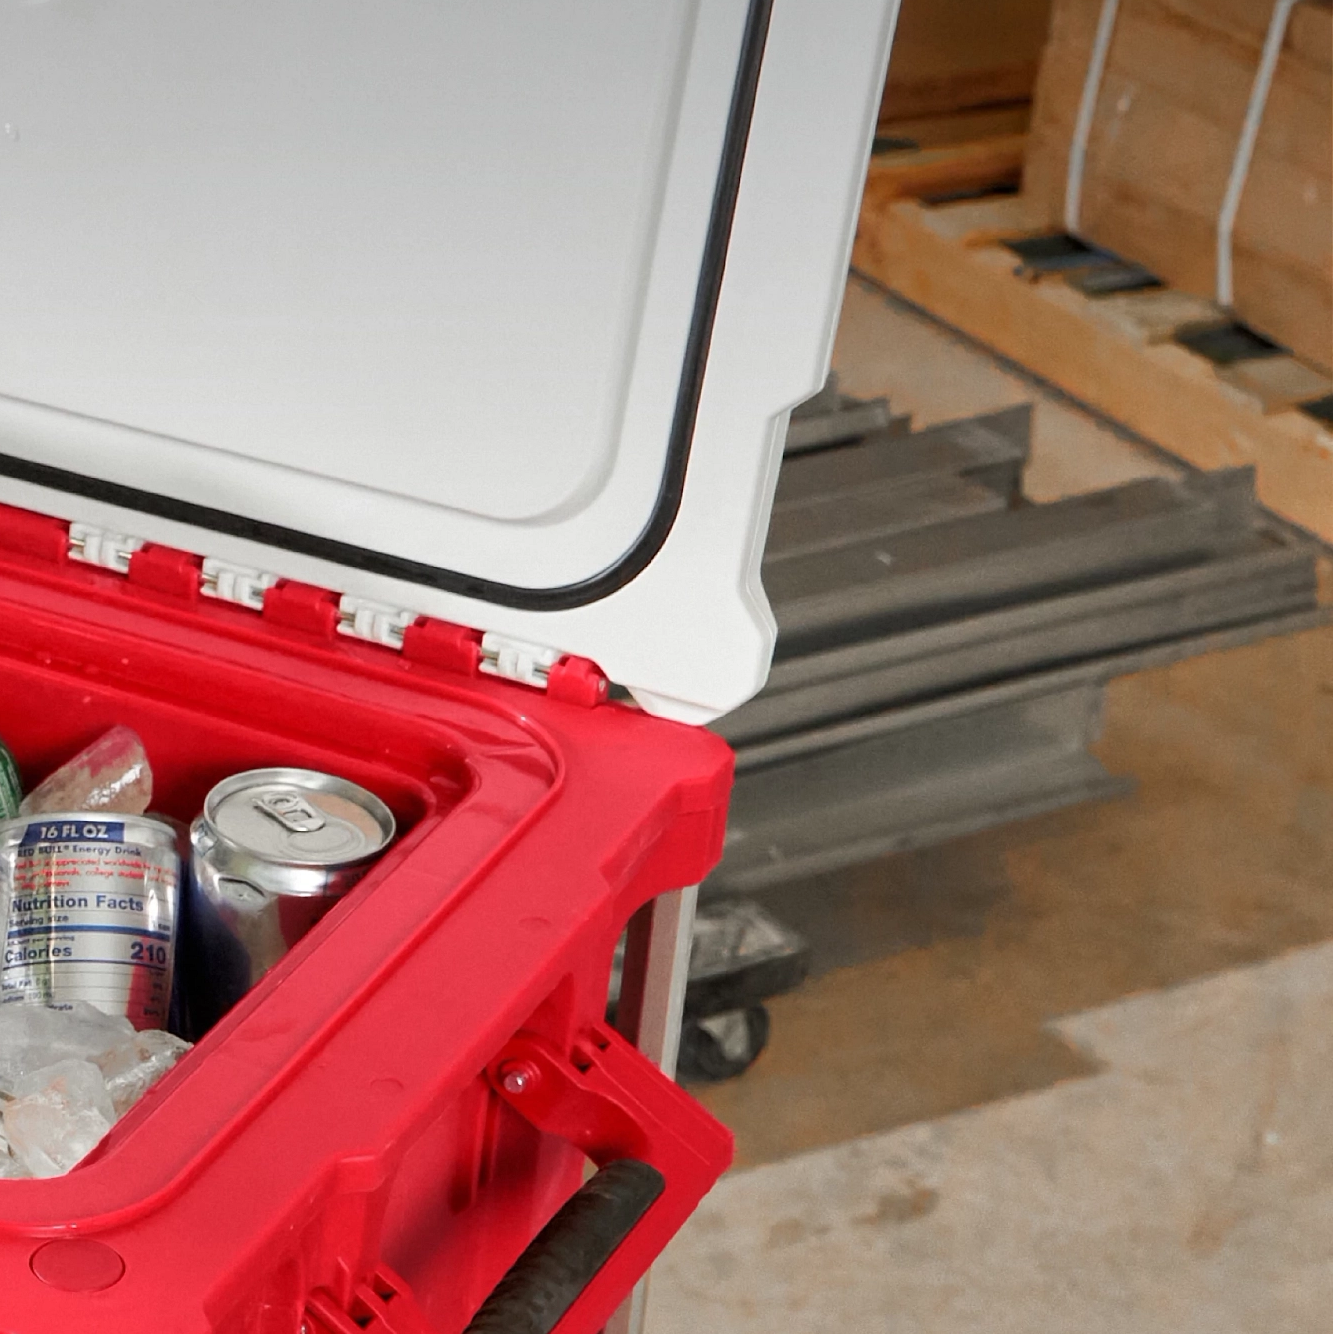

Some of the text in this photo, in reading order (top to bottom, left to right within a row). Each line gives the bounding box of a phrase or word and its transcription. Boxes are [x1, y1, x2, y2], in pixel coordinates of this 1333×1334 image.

[40, 824, 109, 840] 16 FL OZ
[72, 844, 112, 857] Energy
[114, 845, 142, 857] Drink
[11, 894, 145, 914] Nutrition Facts
[9, 915, 44, 928] Serving
[5, 941, 166, 965] Calories 210
